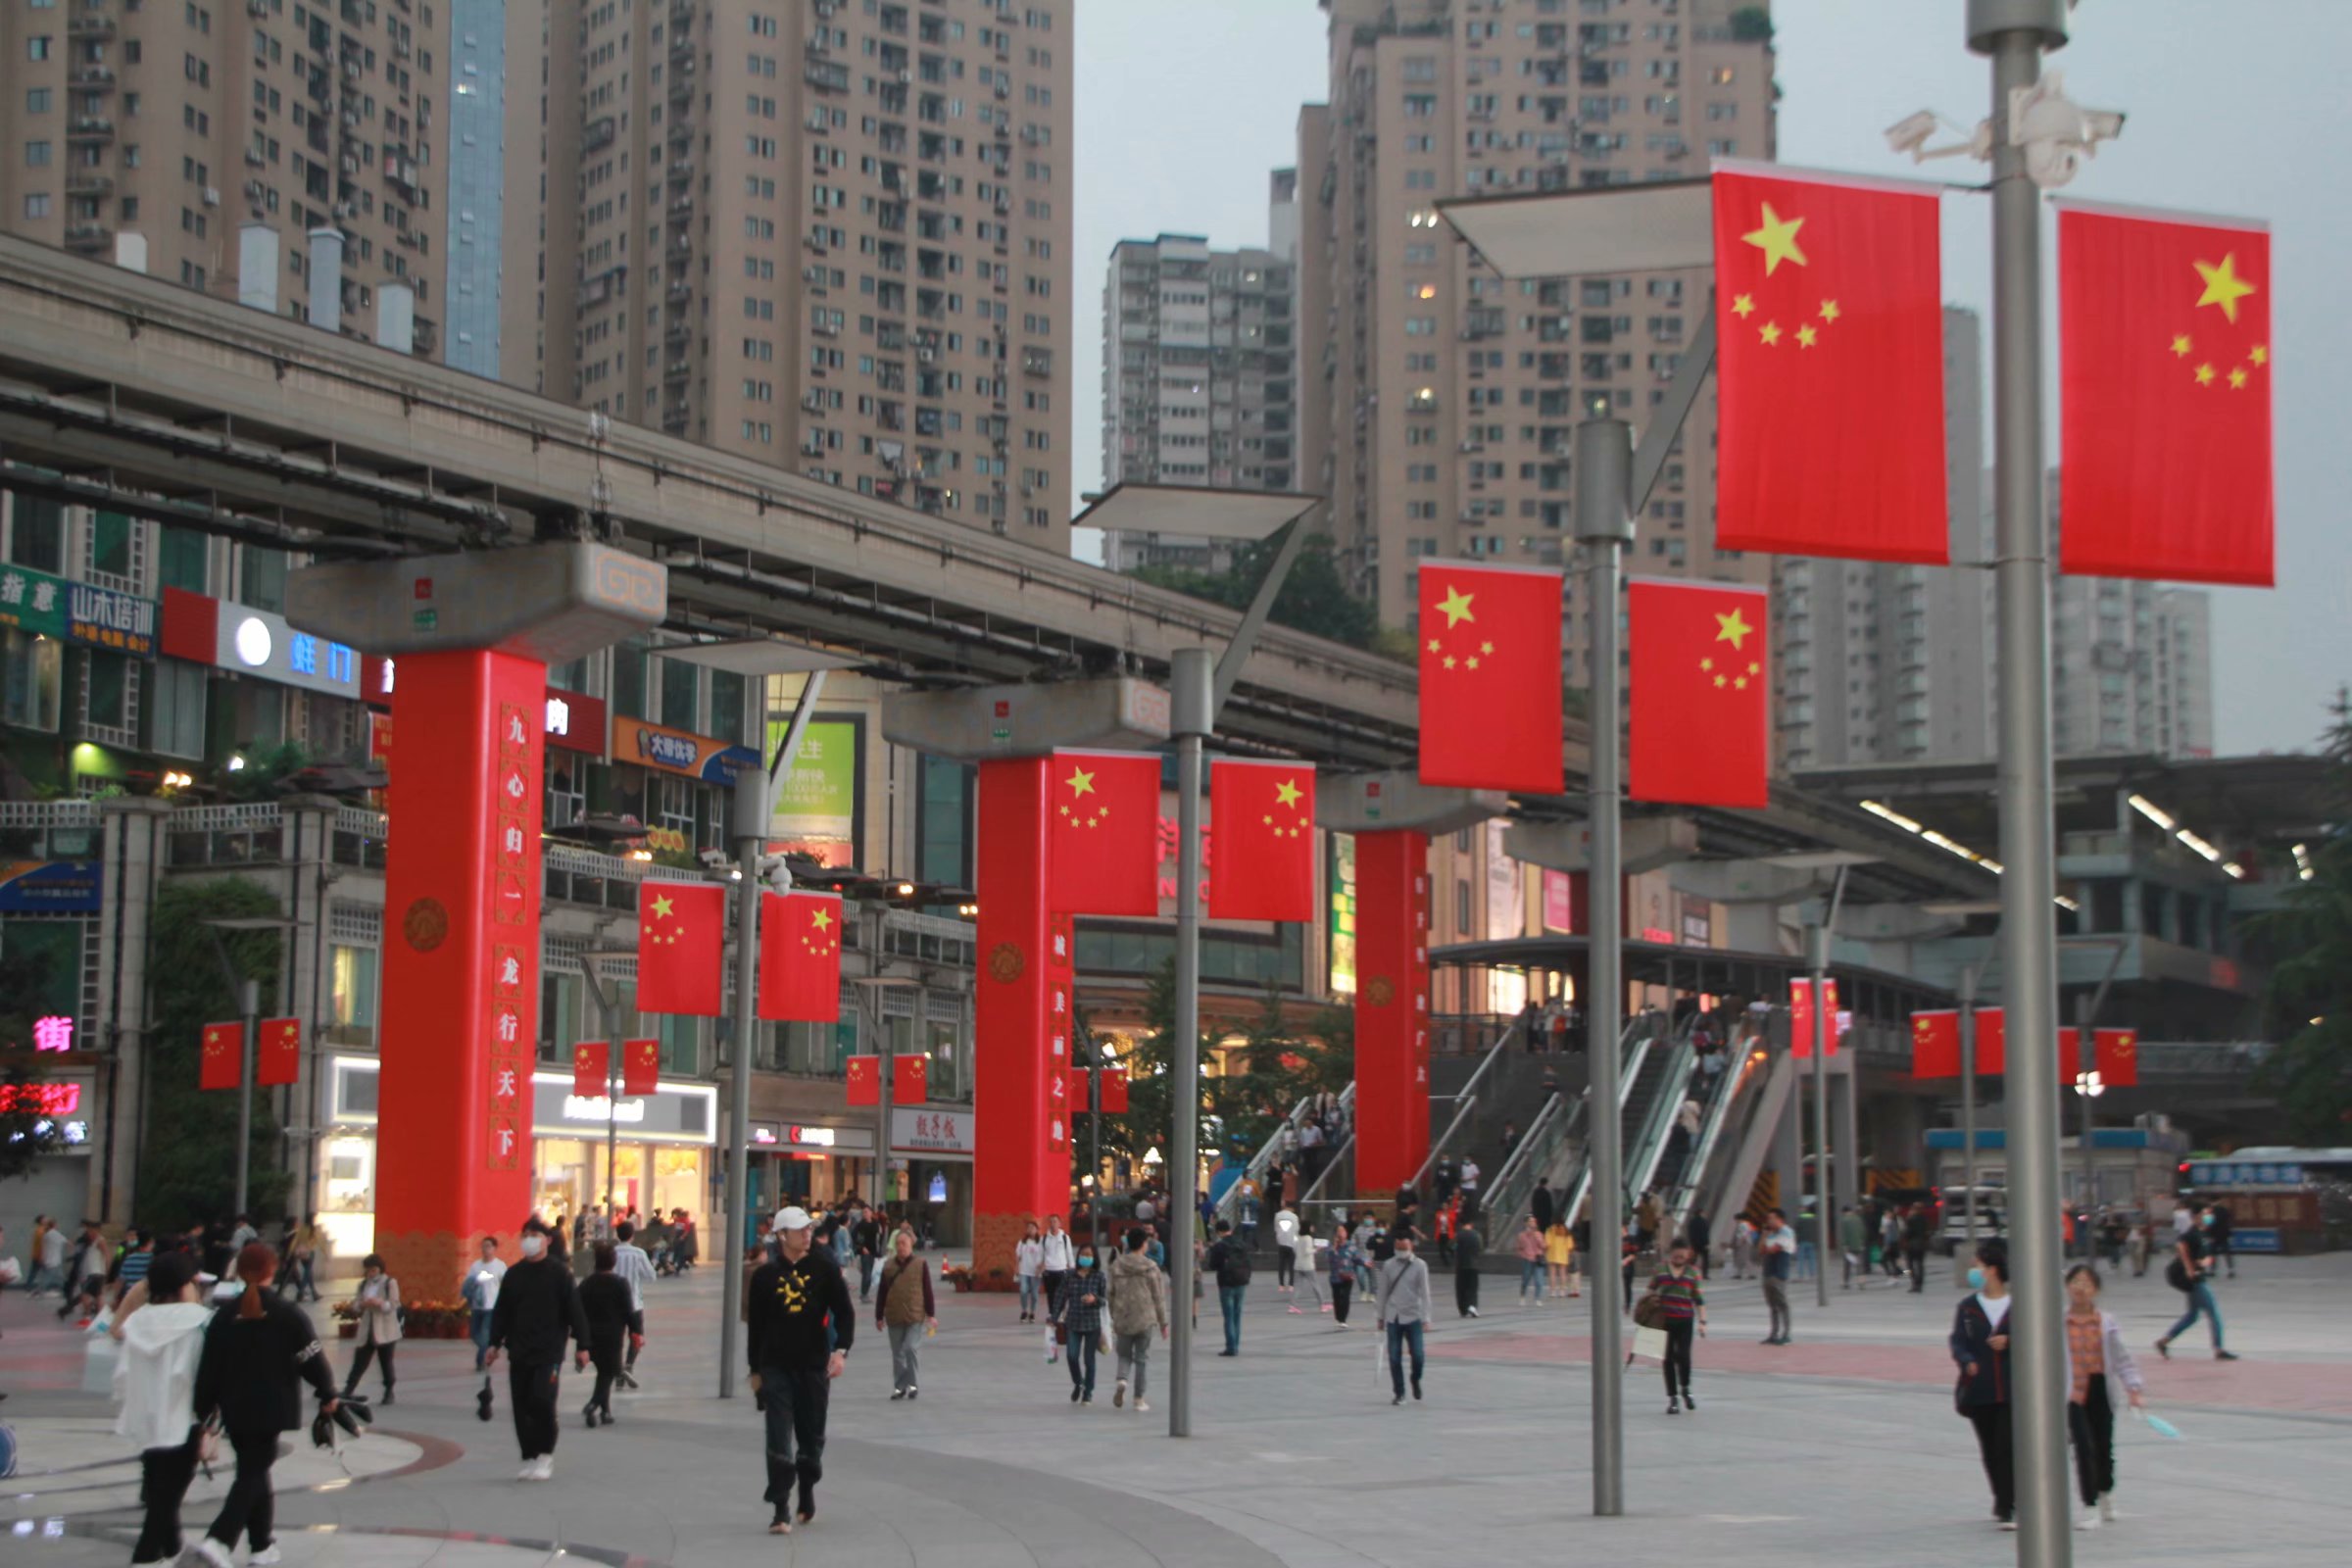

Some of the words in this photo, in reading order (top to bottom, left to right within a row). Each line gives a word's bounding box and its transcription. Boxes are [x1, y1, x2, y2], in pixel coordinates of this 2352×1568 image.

[72, 586, 154, 635] 山木培训
[504, 715, 526, 900] 九心归一
[497, 956, 519, 1155] 龙行天下
